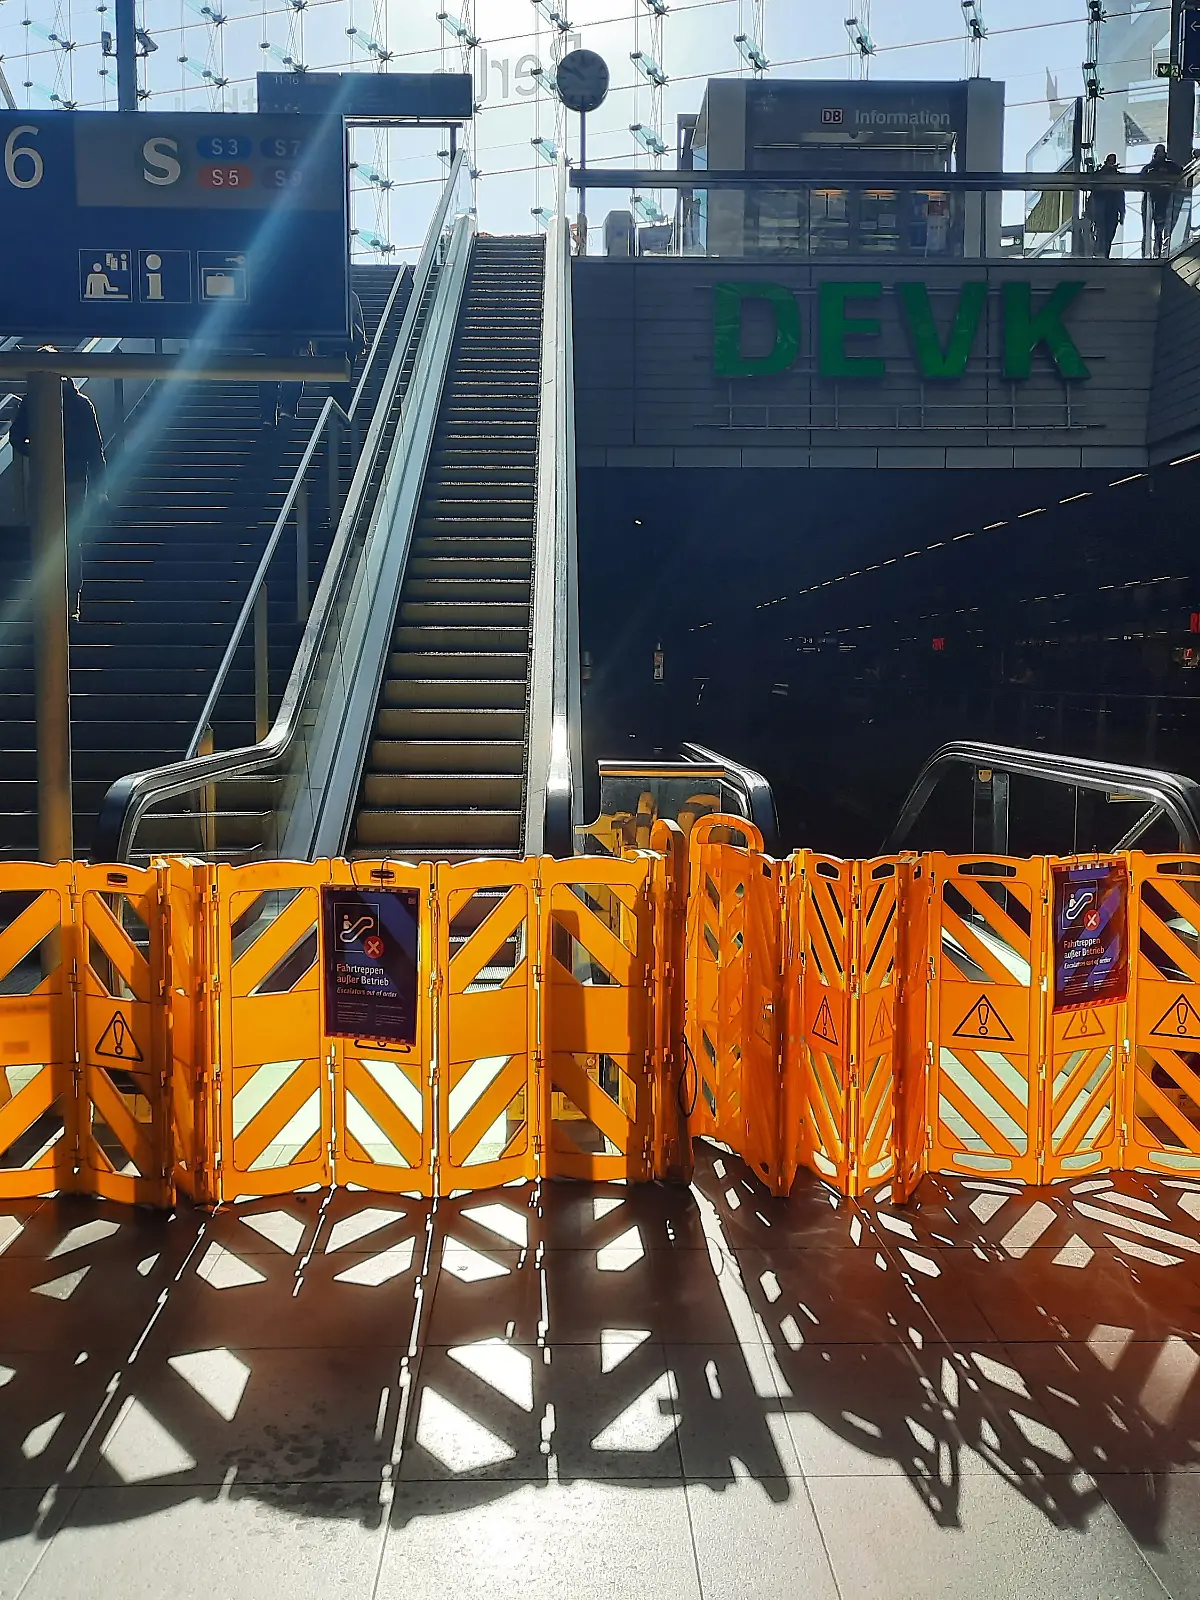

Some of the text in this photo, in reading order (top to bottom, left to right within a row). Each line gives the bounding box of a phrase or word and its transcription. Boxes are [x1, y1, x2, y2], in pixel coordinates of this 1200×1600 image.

[822, 109, 951, 125] DB Information
[4, 125, 44, 189] 6
[142, 137, 182, 186] S
[713, 281, 1091, 381] DEVK
[1063, 938, 1101, 949] Fahrtreppen
[1063, 946, 1105, 961] außer Betrieb
[336, 964, 384, 976] Fahrtreppen
[336, 974, 389, 987] außer Betrieb
[336, 986, 366, 996] Escalators
[366, 989, 376, 997] out
[383, 990, 398, 999] order
